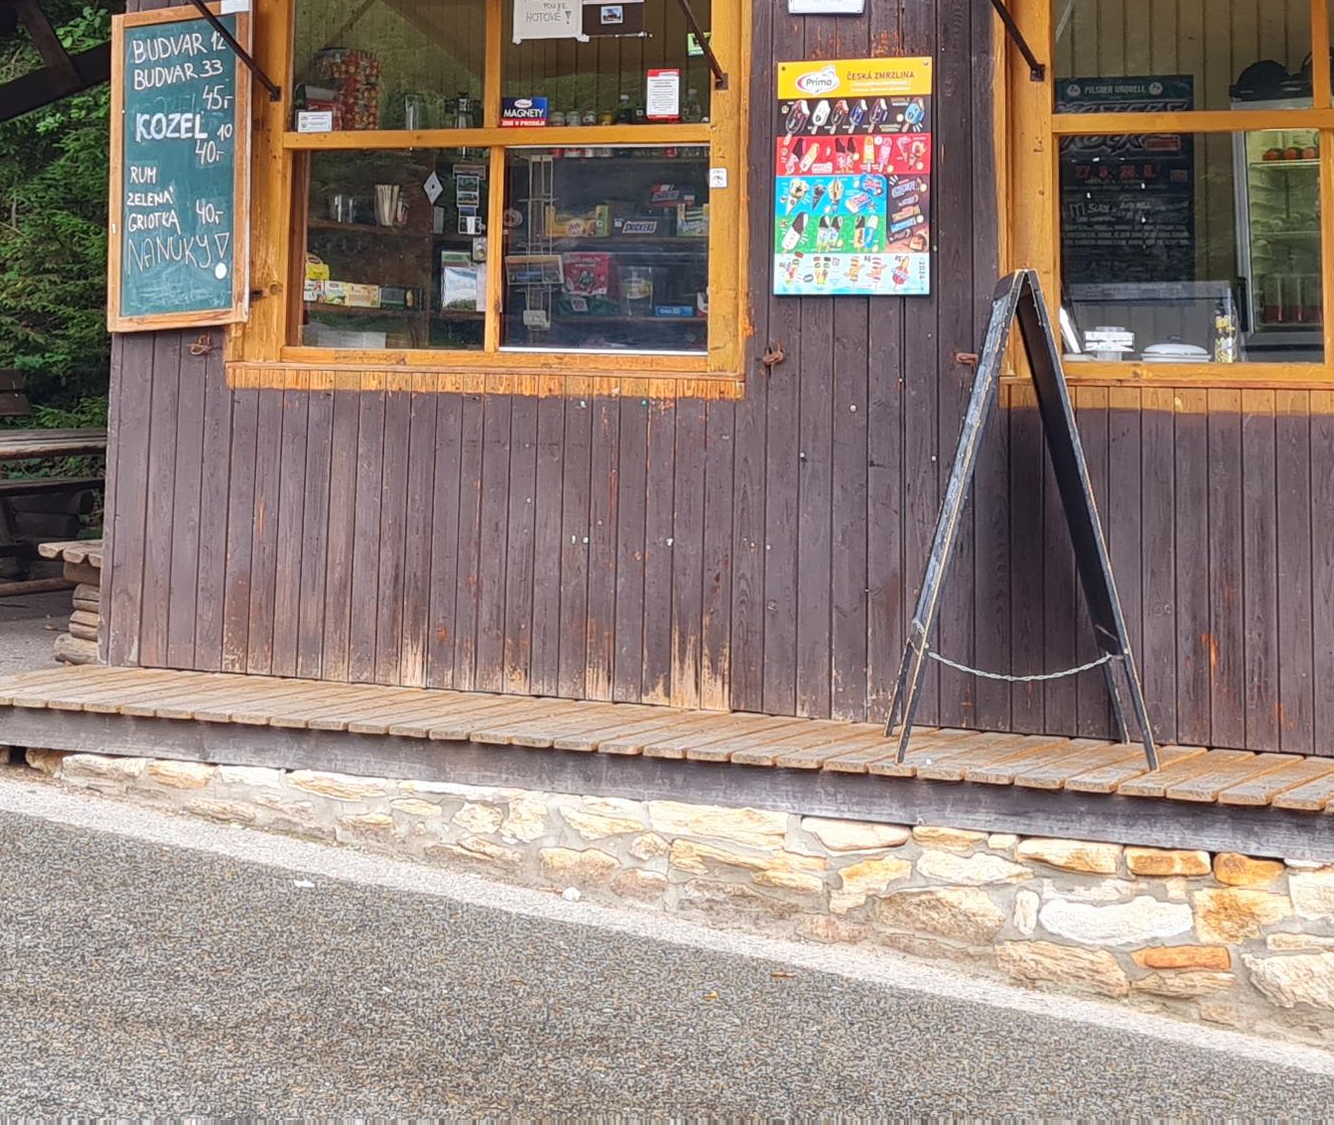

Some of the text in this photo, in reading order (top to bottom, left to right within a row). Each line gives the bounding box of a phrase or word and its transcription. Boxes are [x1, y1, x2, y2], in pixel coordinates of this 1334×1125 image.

[133, 30, 227, 64] BUDVAR 12
[134, 59, 224, 90] BUDVAR 33
[805, 78, 833, 88] Prima
[874, 69, 915, 80] ZMRZLINA
[503, 108, 544, 118] MAGNETY
[135, 112, 233, 143] KOZEL 10
[130, 166, 157, 184] RUM
[127, 186, 174, 207] ZELENÁ
[128, 209, 181, 236] GRIOTKA
[624, 222, 655, 233] SNICKERS
